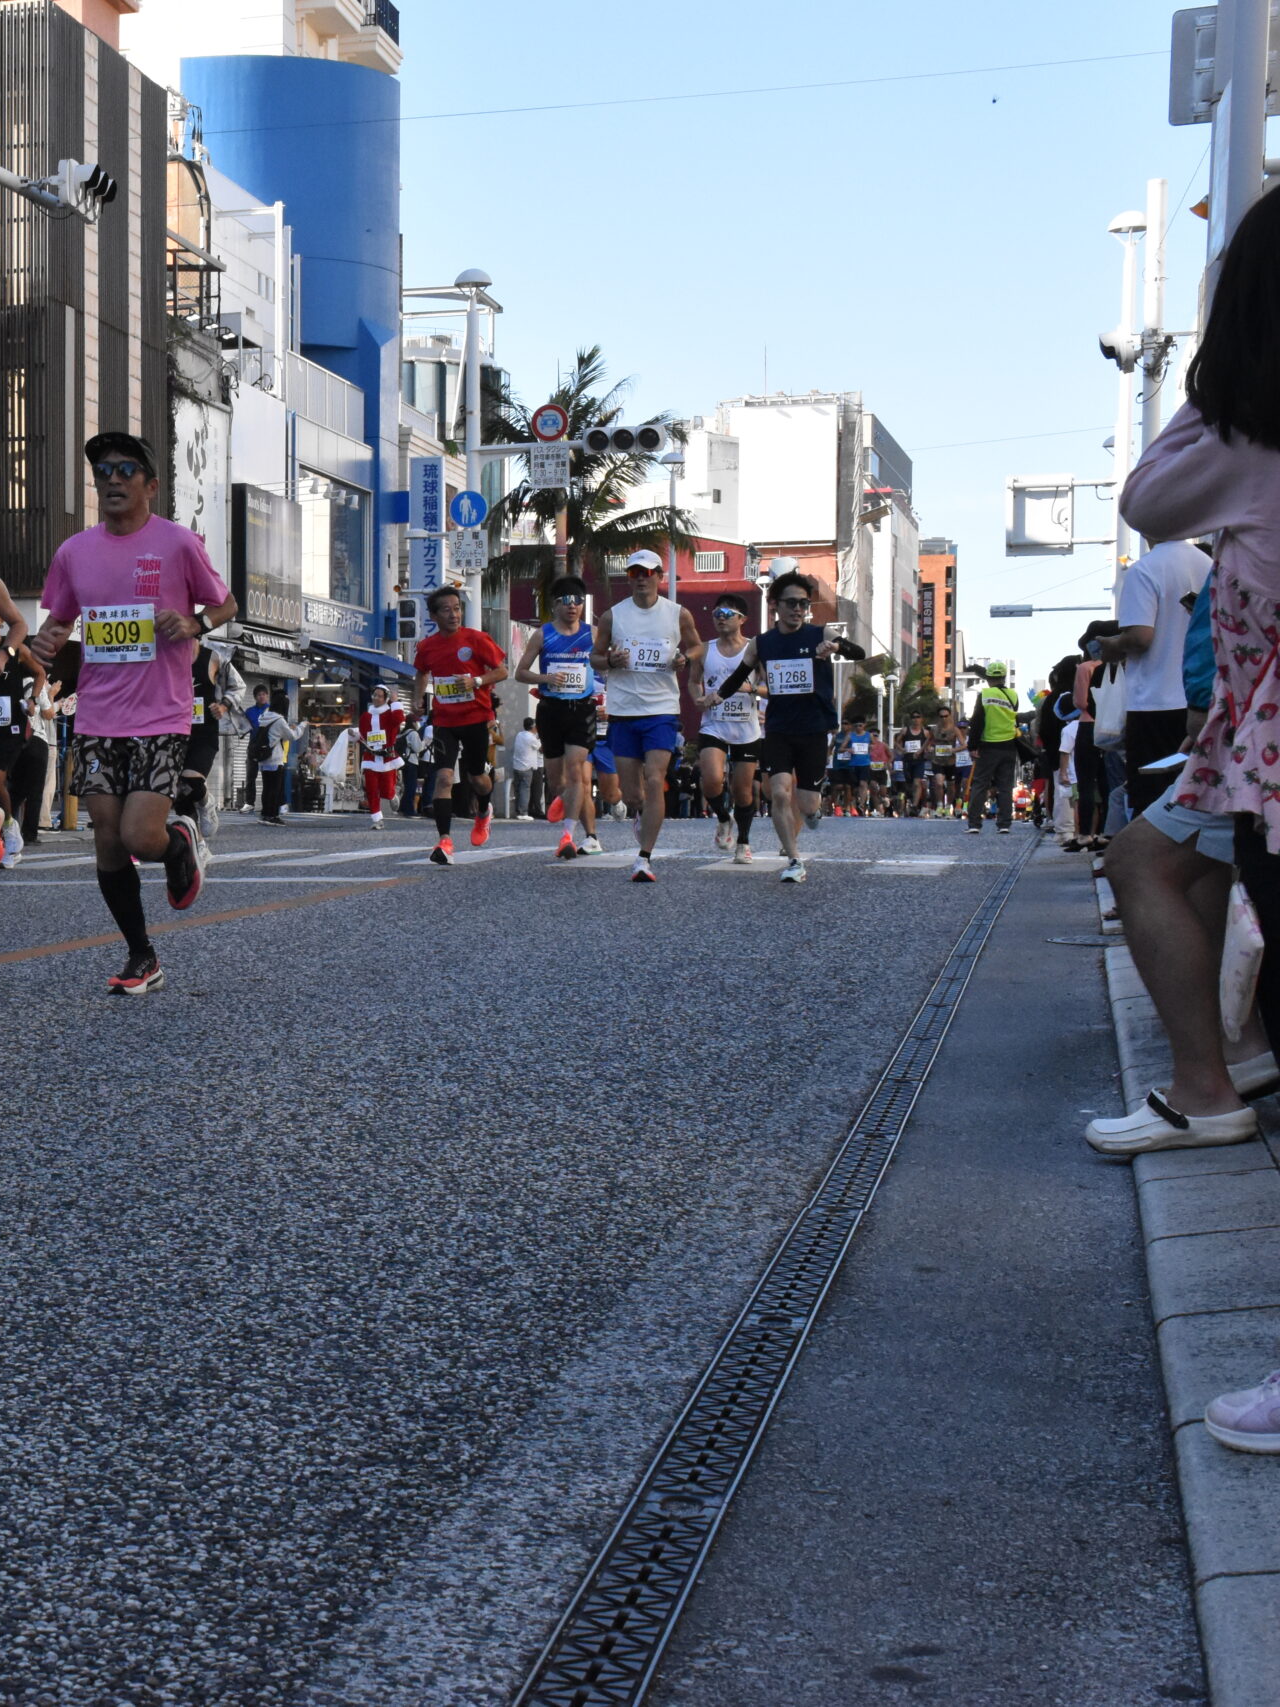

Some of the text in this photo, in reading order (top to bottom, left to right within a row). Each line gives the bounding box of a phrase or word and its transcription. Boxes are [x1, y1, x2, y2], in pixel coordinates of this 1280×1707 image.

[137, 559, 161, 571] PUSH
[98, 609, 141, 620] 琉球銀行
[85, 621, 141, 646] A 309
[638, 648, 660, 662] 879
[768, 670, 807, 684] B 1268
[724, 701, 744, 712] 854
